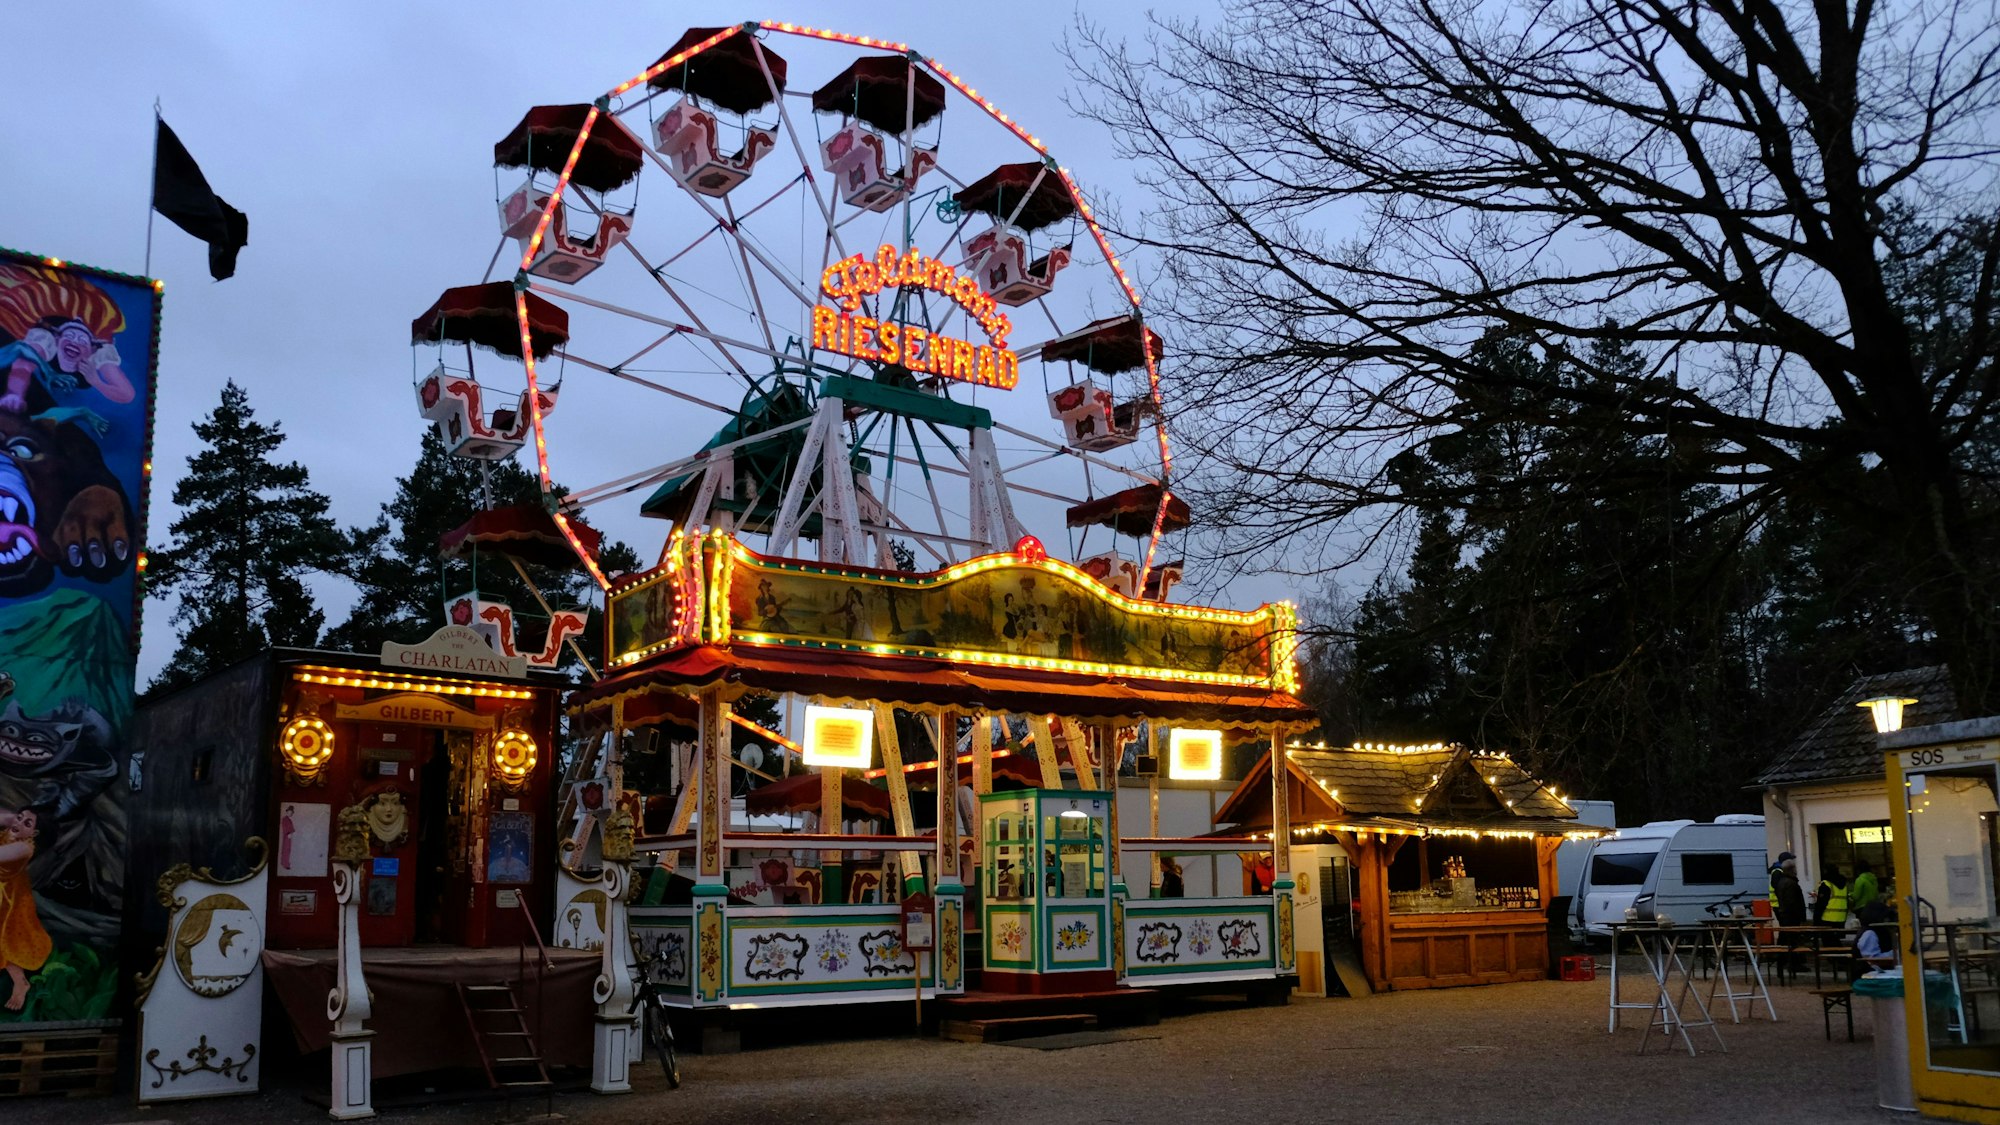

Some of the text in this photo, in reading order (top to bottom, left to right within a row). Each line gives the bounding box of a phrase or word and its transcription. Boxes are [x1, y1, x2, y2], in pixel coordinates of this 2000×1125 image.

[822, 243, 1012, 348] Feldmann
[813, 304, 1019, 390] RIESENRAD
[439, 630, 478, 645] GILBERT
[400, 651, 511, 675] CHARLATAN
[380, 705, 455, 723] GILBERT
[1911, 748, 1944, 766] SOS
